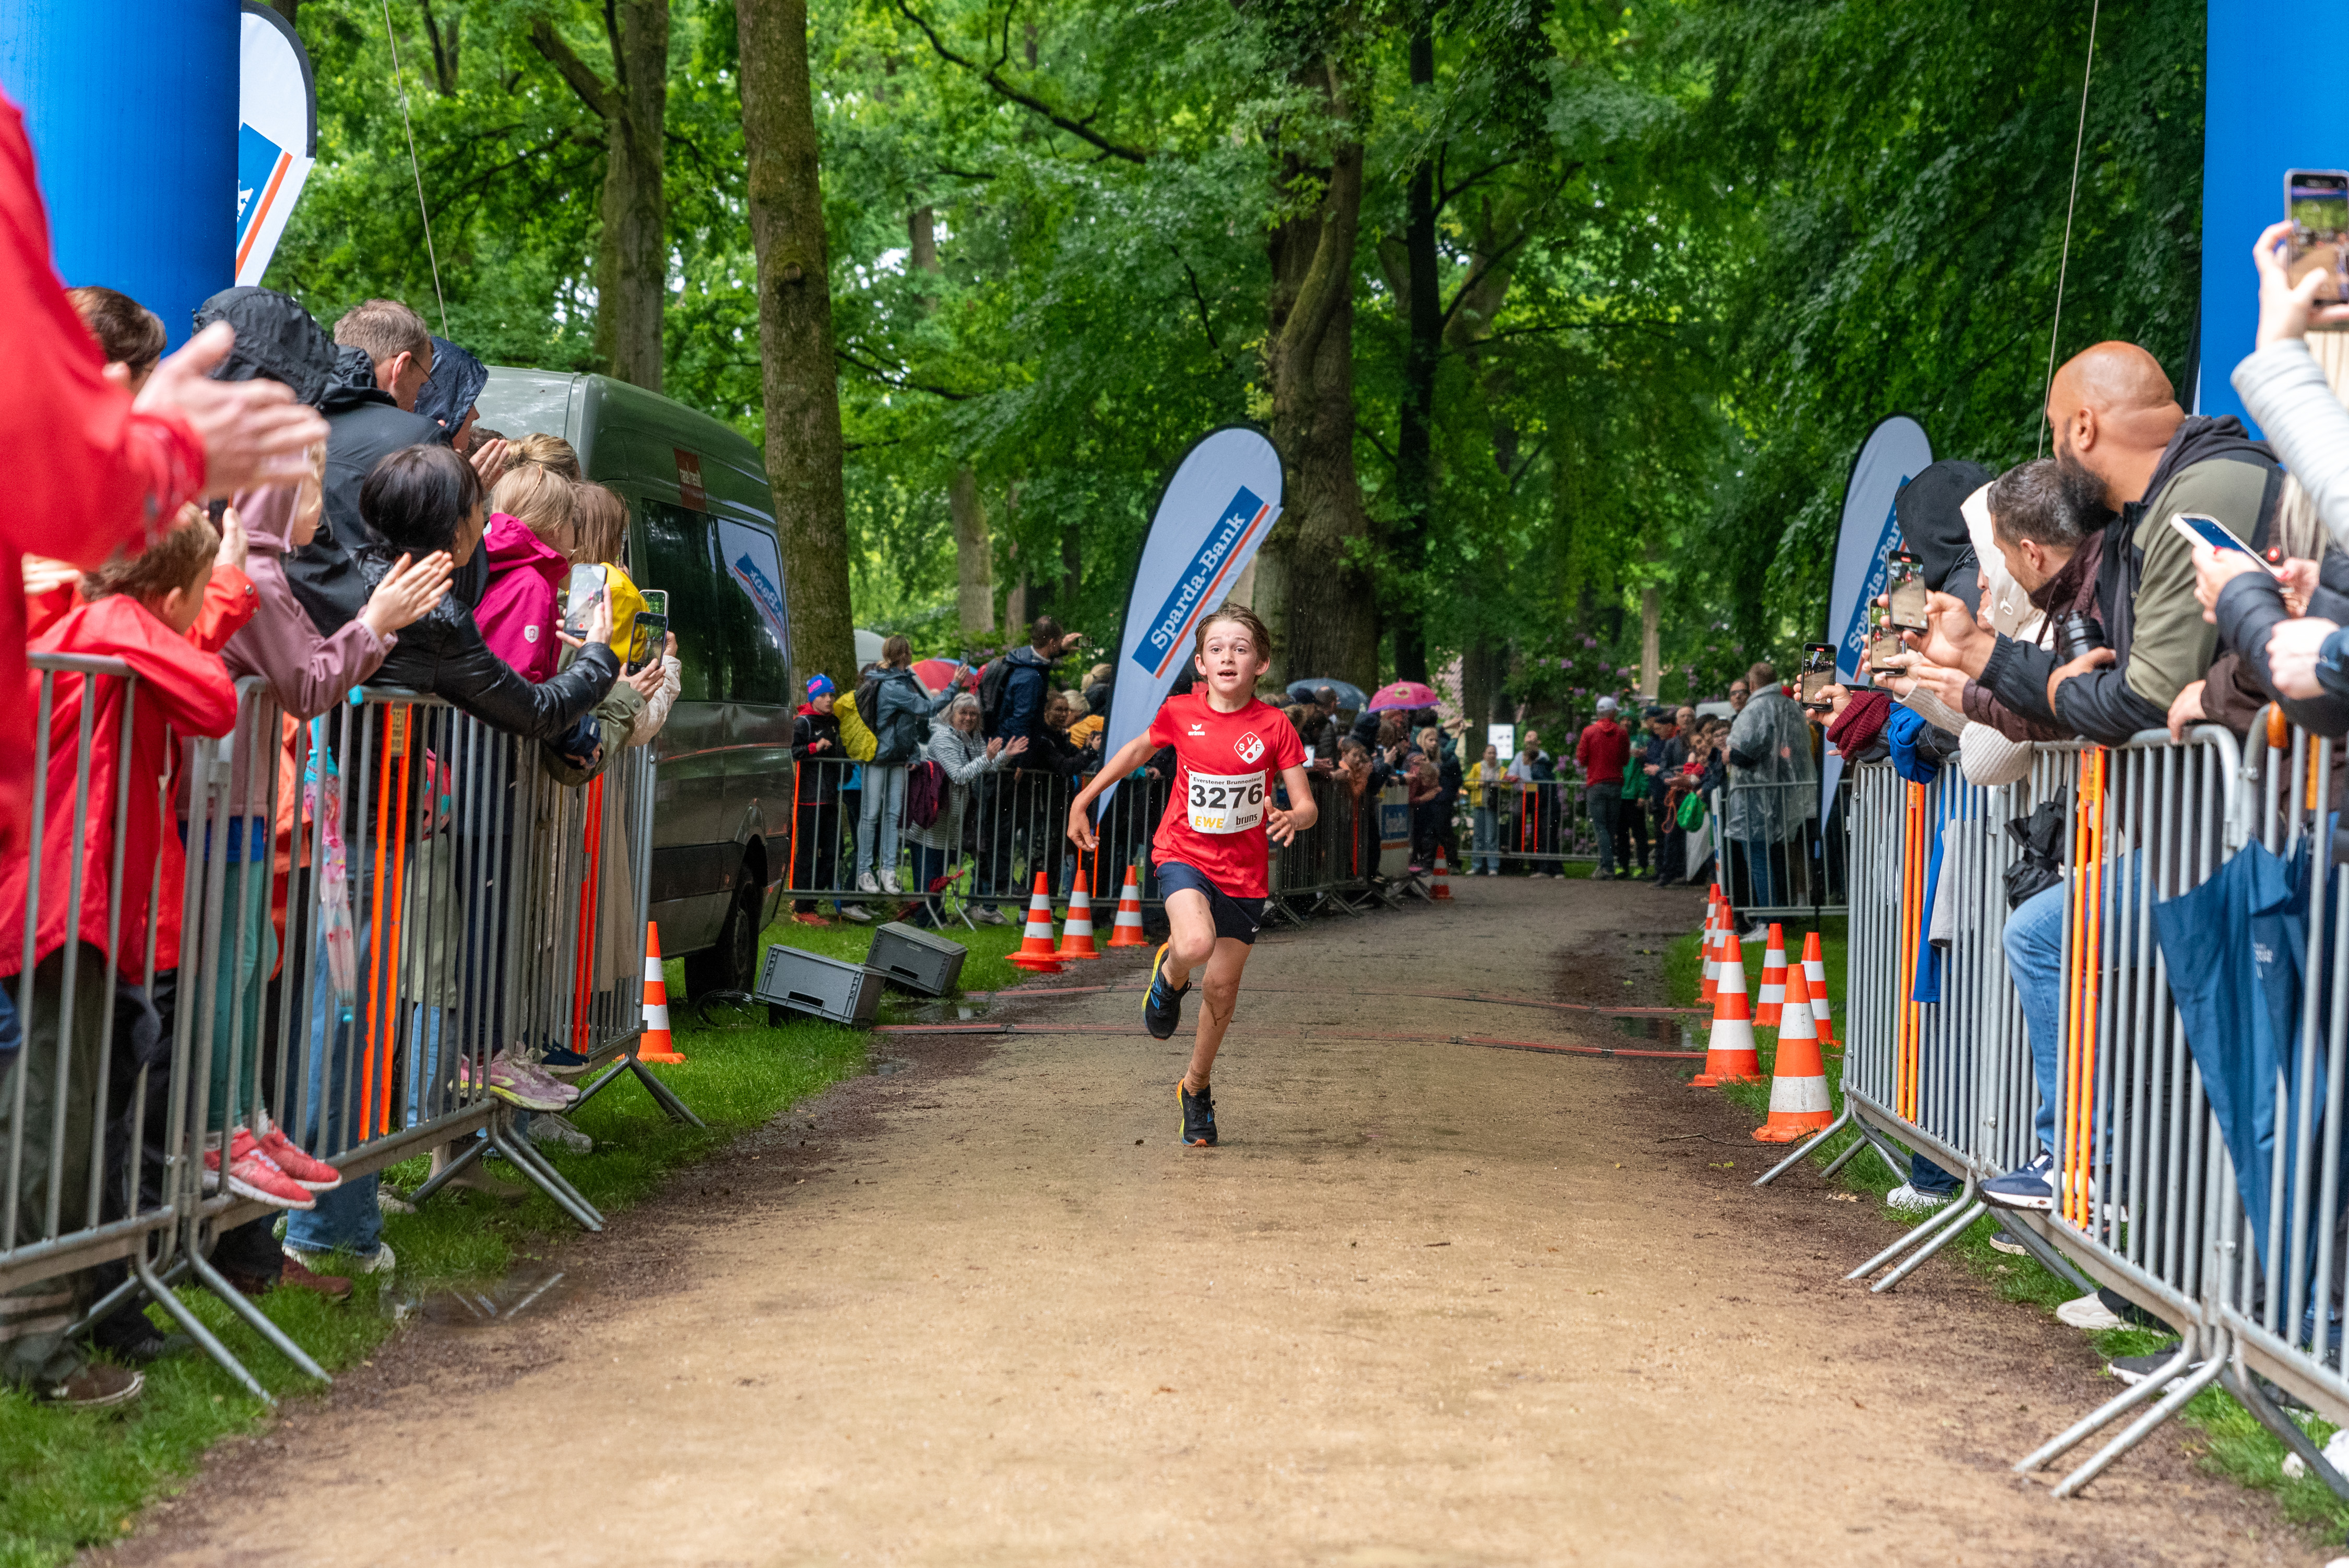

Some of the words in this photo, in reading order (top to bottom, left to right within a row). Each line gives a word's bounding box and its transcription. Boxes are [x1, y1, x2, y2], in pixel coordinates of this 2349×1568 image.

[1151, 513, 1245, 650] Sparda-Bank
[1193, 777, 1225, 785] Everstener
[1227, 776, 1262, 785] Brunnenlauf
[1191, 783, 1263, 809] 3276
[1195, 816, 1224, 829] EWE
[1236, 813, 1258, 825] bruns
